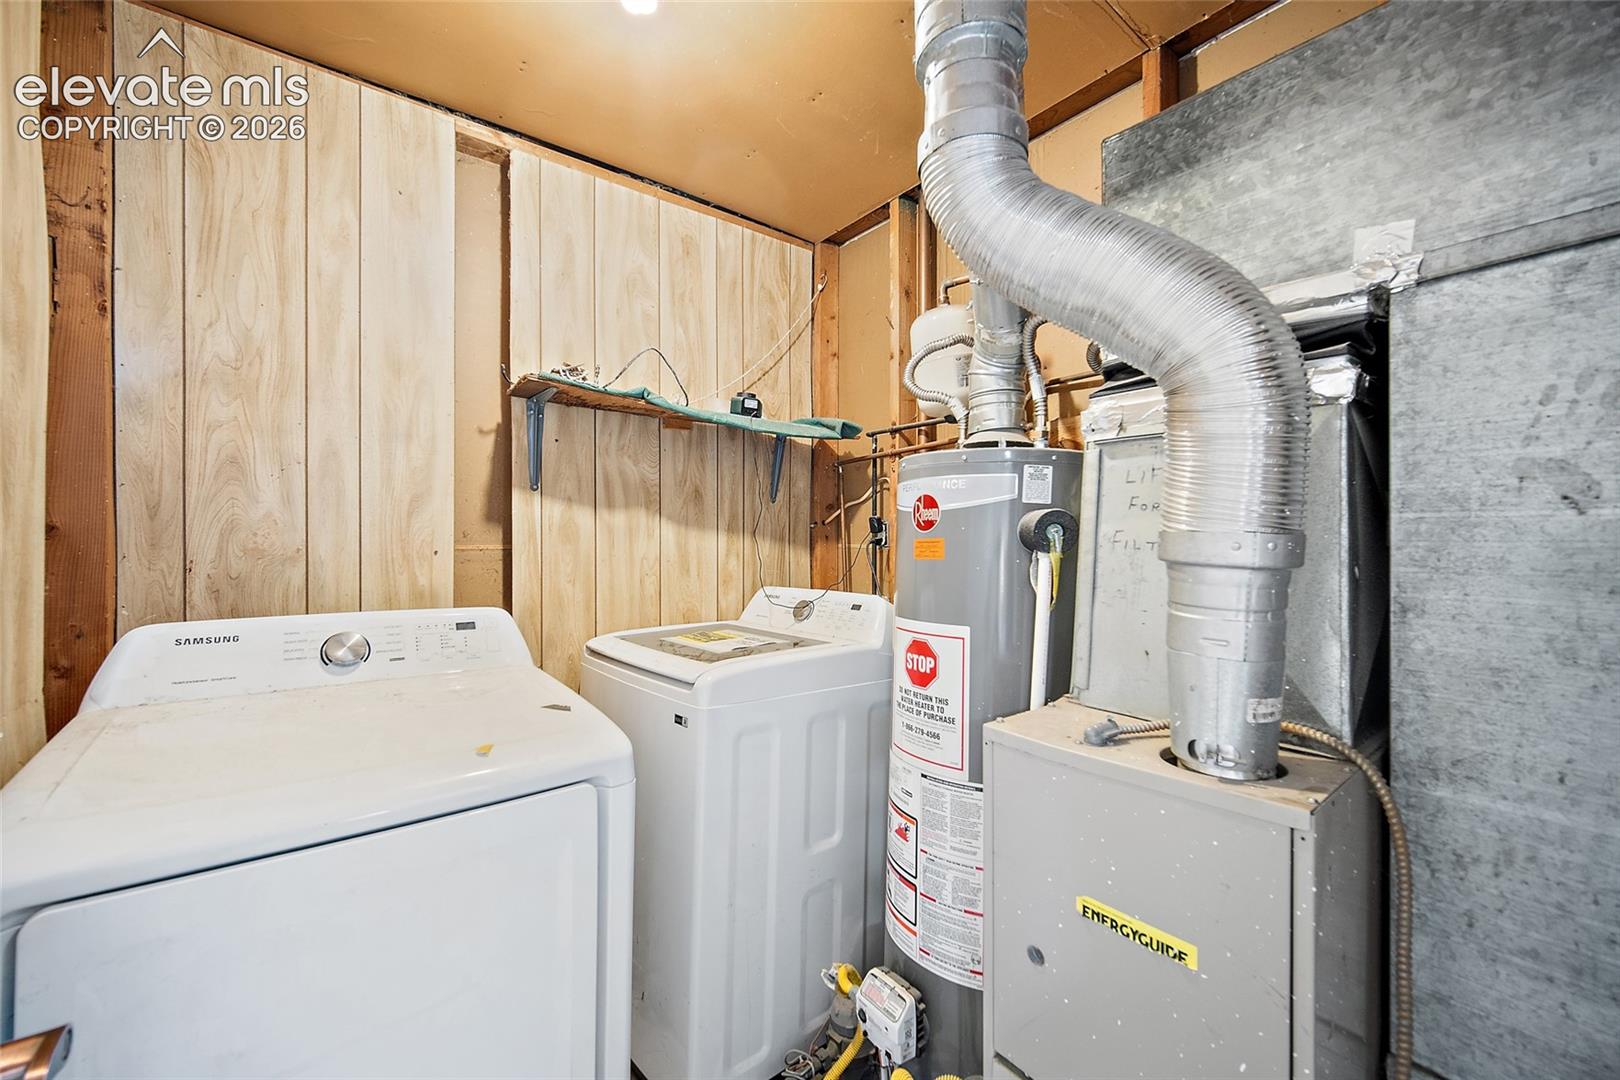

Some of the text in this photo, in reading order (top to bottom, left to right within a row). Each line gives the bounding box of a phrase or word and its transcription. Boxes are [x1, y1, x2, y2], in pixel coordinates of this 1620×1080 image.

[1126, 465, 1163, 484] LIF
[914, 495, 939, 526] Rheem
[1110, 529, 1158, 551] FILT
[174, 635, 240, 646] SAMSUNG
[906, 652, 935, 674] STOP
[913, 690, 933, 703] RETURN
[935, 696, 949, 706] THIS
[915, 700, 935, 712] HEATER
[936, 705, 945, 714] TO
[901, 703, 914, 715] PLACE
[915, 708, 922, 717] OF
[923, 711, 956, 725] PURCHASE
